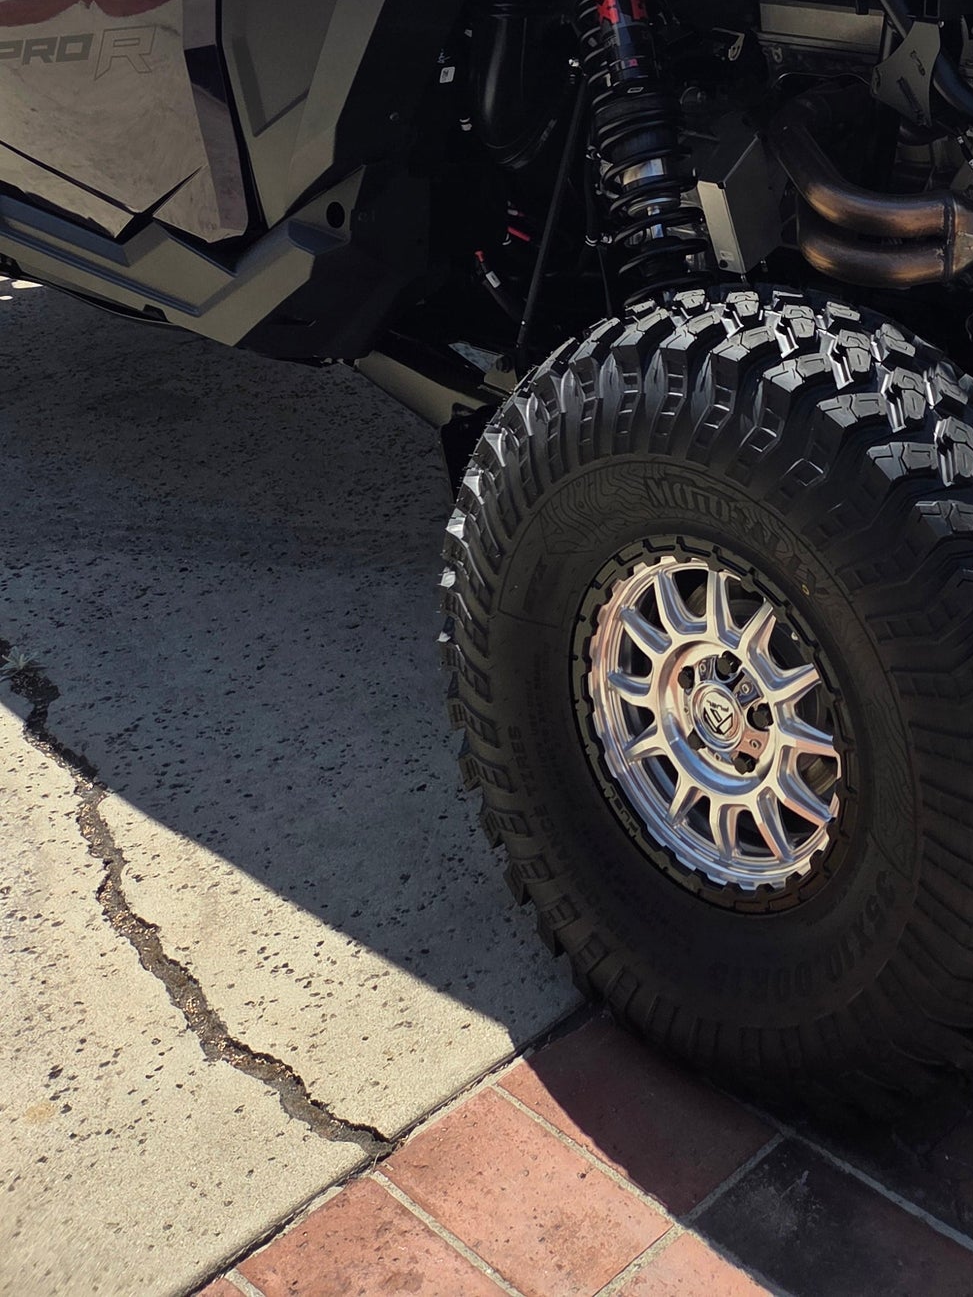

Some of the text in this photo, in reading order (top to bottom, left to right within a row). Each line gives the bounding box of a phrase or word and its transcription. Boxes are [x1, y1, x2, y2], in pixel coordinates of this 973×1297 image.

[0, 27, 158, 80] PRO R
[508, 724, 538, 798] TIRES
